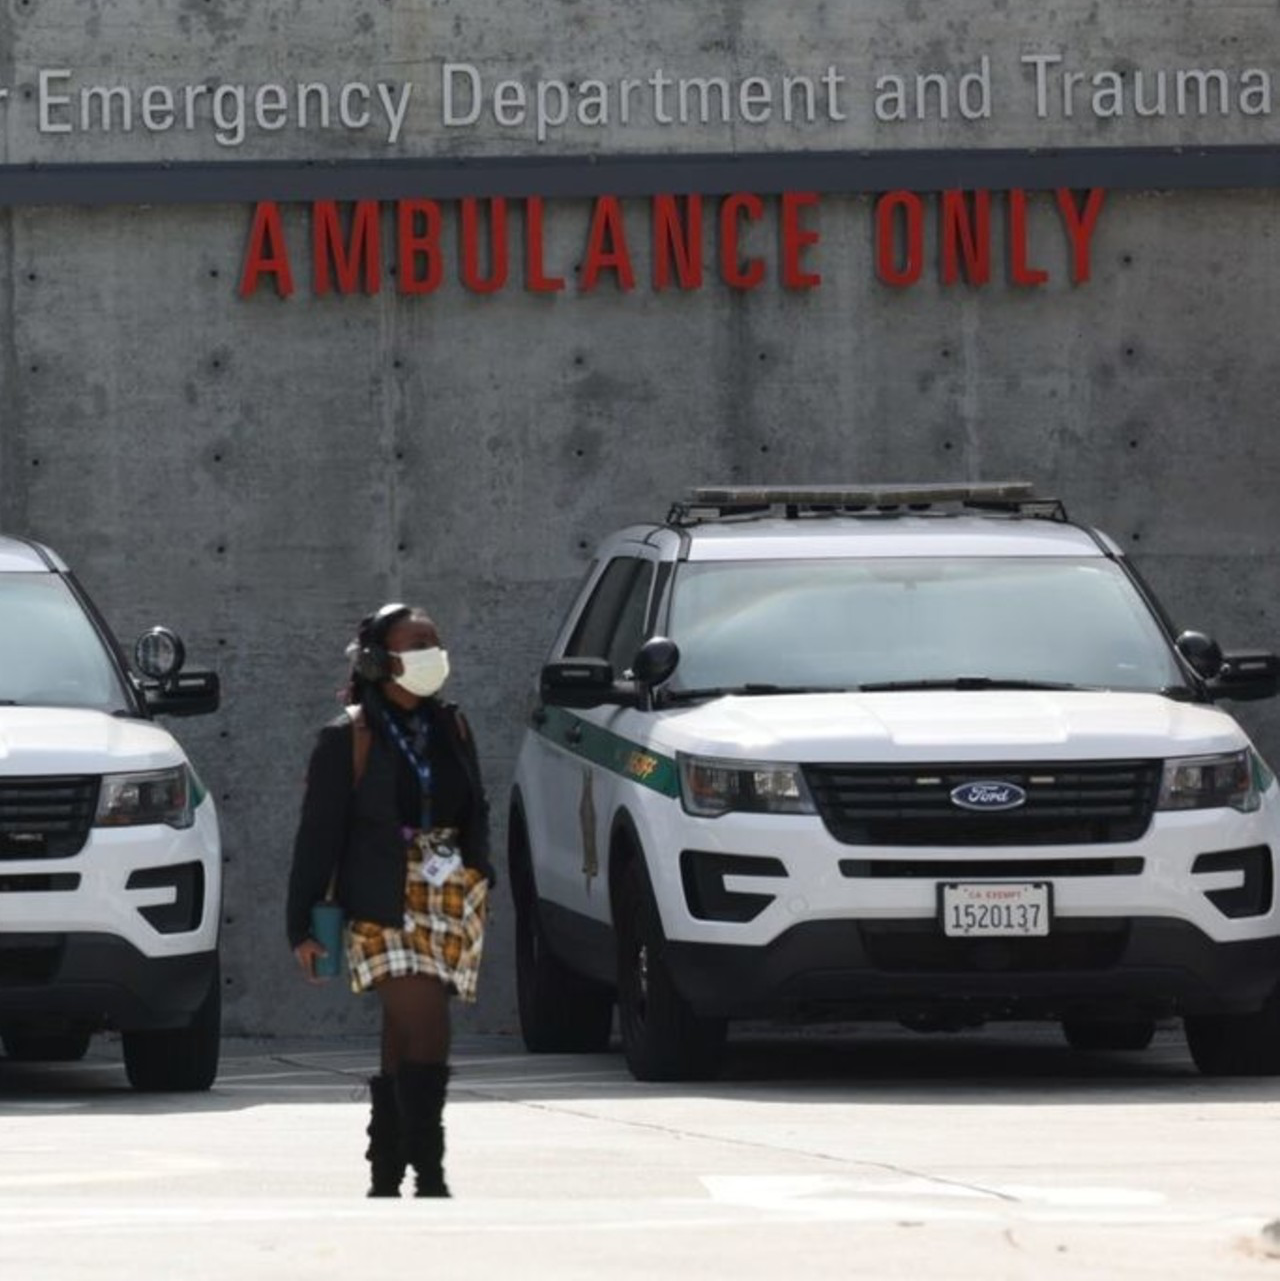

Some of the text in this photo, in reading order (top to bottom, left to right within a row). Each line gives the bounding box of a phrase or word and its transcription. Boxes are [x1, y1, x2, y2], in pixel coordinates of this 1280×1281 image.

[38, 69, 413, 146] Emergency
[441, 62, 846, 143] Department
[873, 55, 991, 119] and
[1019, 53, 1272, 118] Trauma
[240, 187, 1106, 298] AMBULANCE ONLY
[968, 785, 1010, 802] Ford
[952, 903, 1041, 929] 1520137
